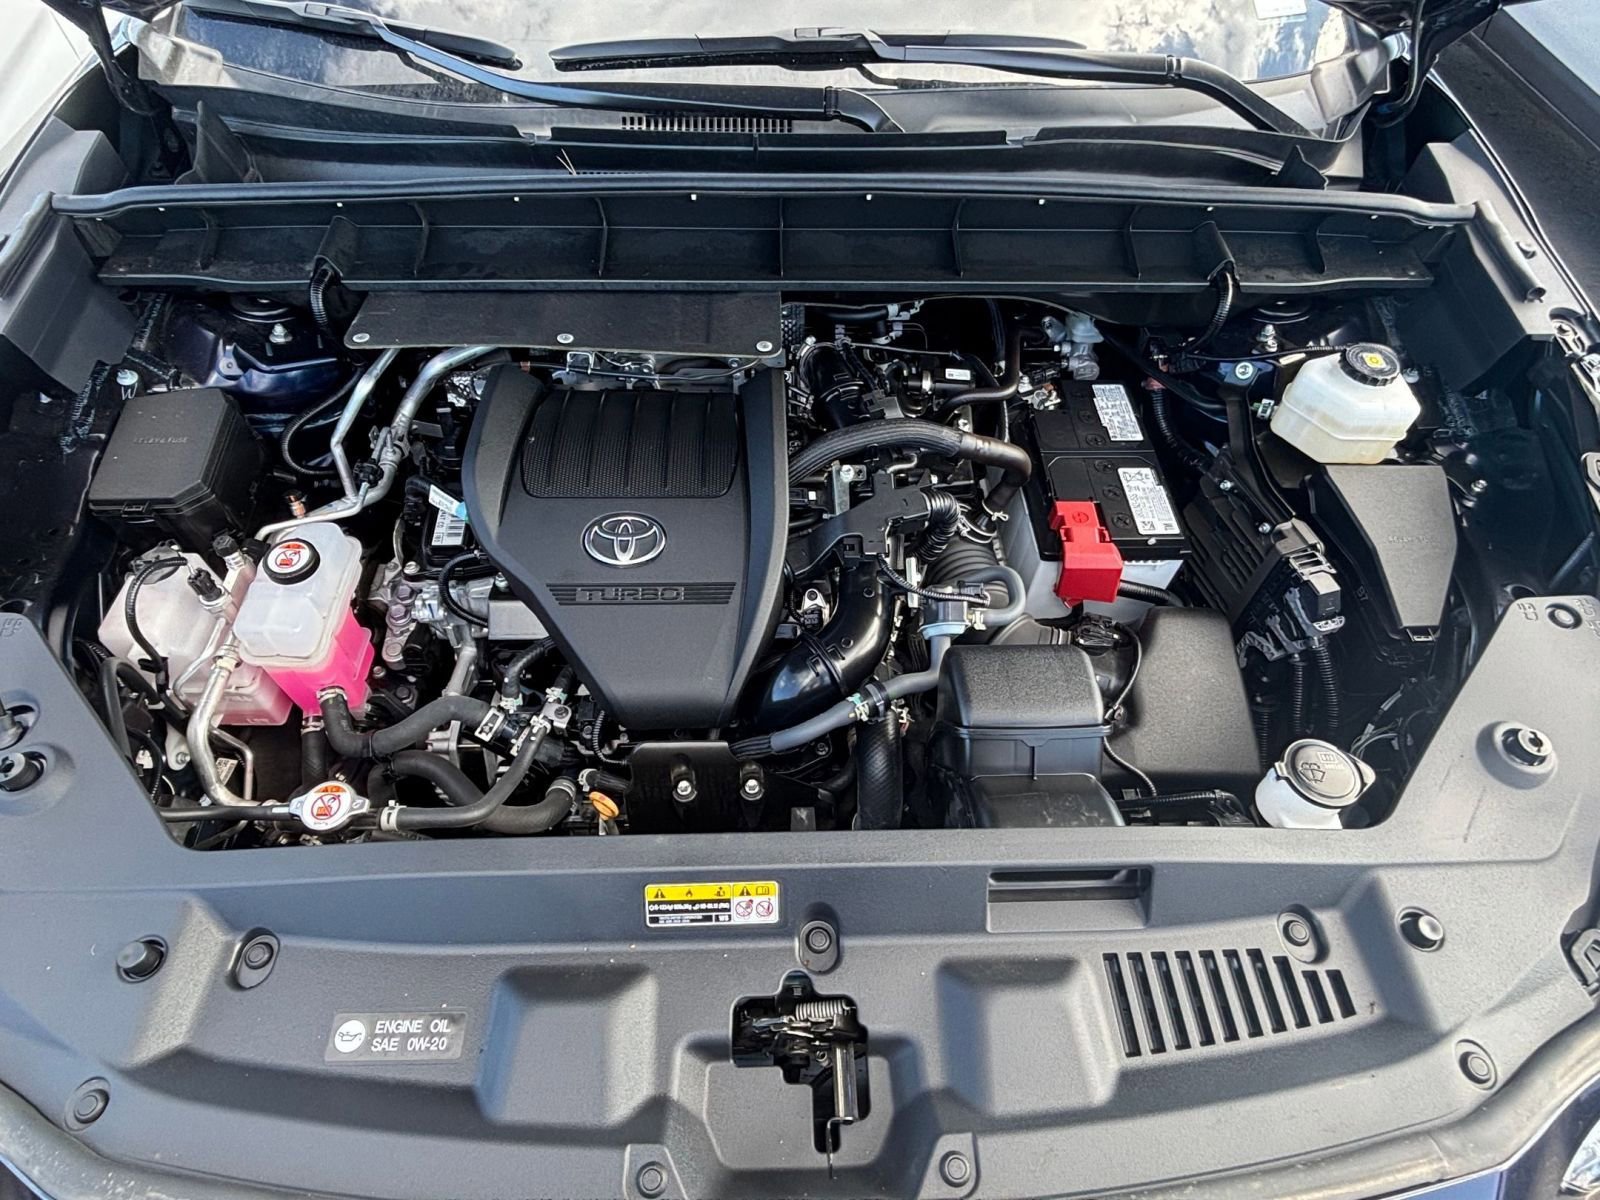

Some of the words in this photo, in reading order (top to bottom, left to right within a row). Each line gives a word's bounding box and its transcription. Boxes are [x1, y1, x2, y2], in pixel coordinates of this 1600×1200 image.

[576, 587, 685, 601] TURBO
[374, 1020, 423, 1033] ENGINE
[430, 1019, 451, 1033] OIL
[371, 1037, 400, 1051] SAE
[407, 1037, 447, 1051] 0W-20
